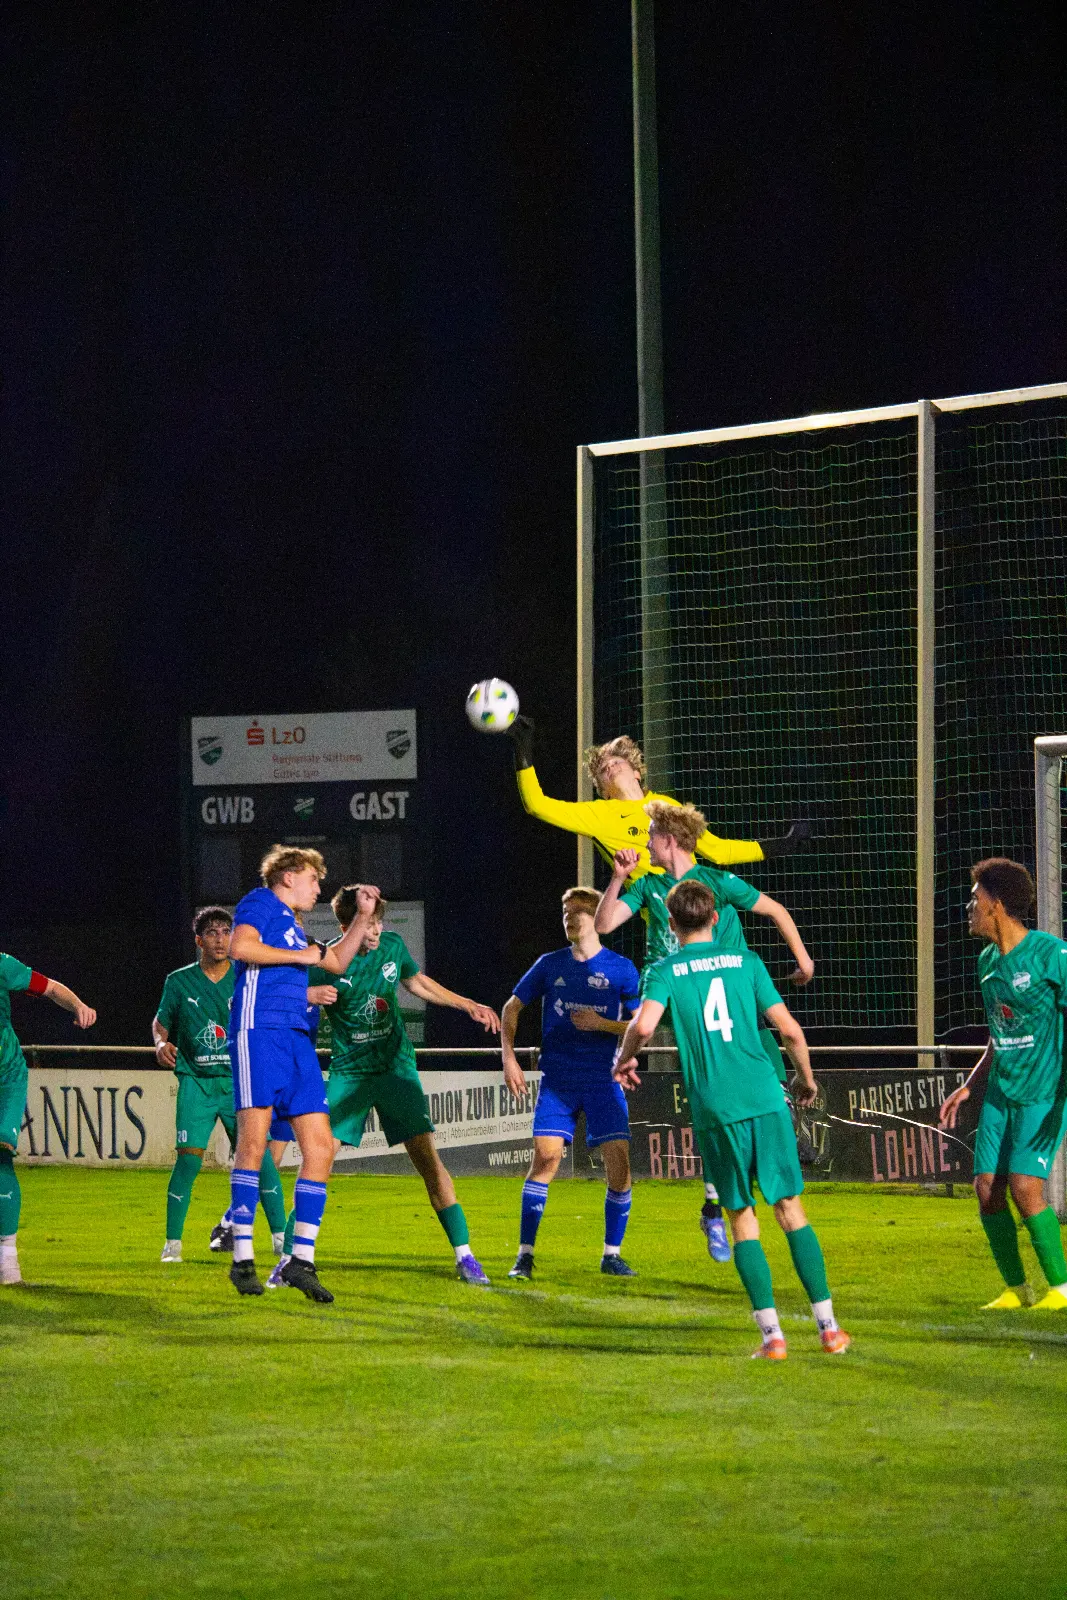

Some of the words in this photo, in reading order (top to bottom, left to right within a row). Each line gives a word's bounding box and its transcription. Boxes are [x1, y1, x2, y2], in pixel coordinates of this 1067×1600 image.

[201, 797, 255, 825] GWB
[350, 791, 410, 821] GAST
[703, 976, 734, 1042] 4
[424, 1090, 463, 1125] DION
[466, 1086, 495, 1121] ZUM
[849, 1081, 914, 1120] PARISER
[648, 1127, 703, 1179] RAB
